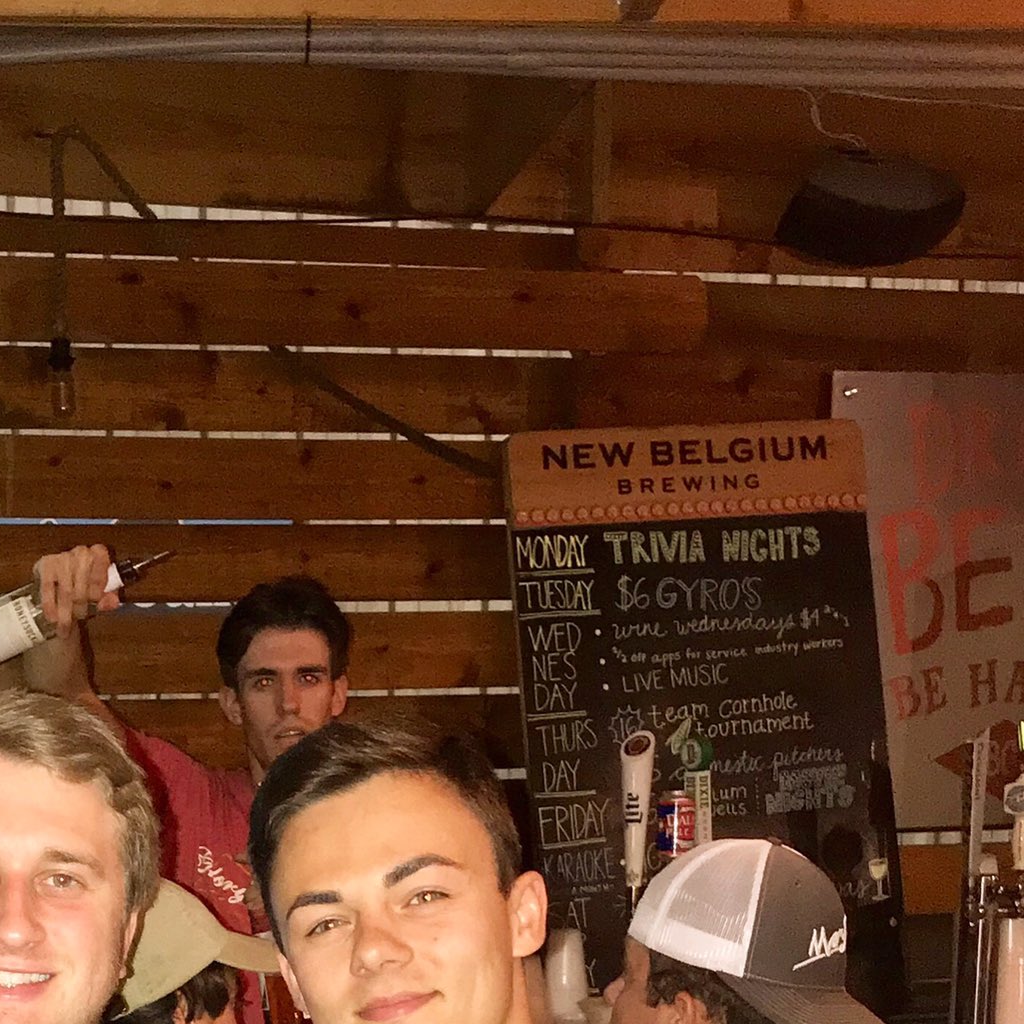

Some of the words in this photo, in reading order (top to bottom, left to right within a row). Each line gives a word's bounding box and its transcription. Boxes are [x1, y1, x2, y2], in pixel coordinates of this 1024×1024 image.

[542, 441, 635, 470] NEW
[650, 435, 827, 467] BELGIUM
[617, 473, 761, 495] BREWING
[516, 534, 589, 569] MONDAY
[603, 530, 707, 565] TRIVIA
[721, 526, 821, 563] NIGHTS
[519, 579, 595, 610] TUESDAY
[655, 577, 763, 609] GYROS
[527, 622, 582, 652] WED
[612, 622, 666, 640] wine
[673, 612, 796, 639] wednesdays
[532, 651, 577, 681] NES
[630, 651, 647, 664] off
[650, 650, 681, 668] apps
[686, 647, 700, 660] for
[706, 647, 748, 661] service
[755, 641, 800, 657] industry
[803, 638, 844, 651] workers
[534, 682, 578, 711] DAY
[622, 669, 664, 693] LIVE
[670, 663, 729, 689] MUSIC
[886, 665, 949, 721] BE
[535, 718, 598, 756] THURS
[647, 702, 710, 729] team
[718, 691, 799, 719] cornhole
[695, 711, 815, 739] tournament
[542, 758, 580, 793] DAY
[767, 746, 844, 782] pitchers
[699, 774, 709, 809] DIXIE
[538, 798, 610, 845] FRIDAY
[542, 847, 616, 882] KARAOKE
